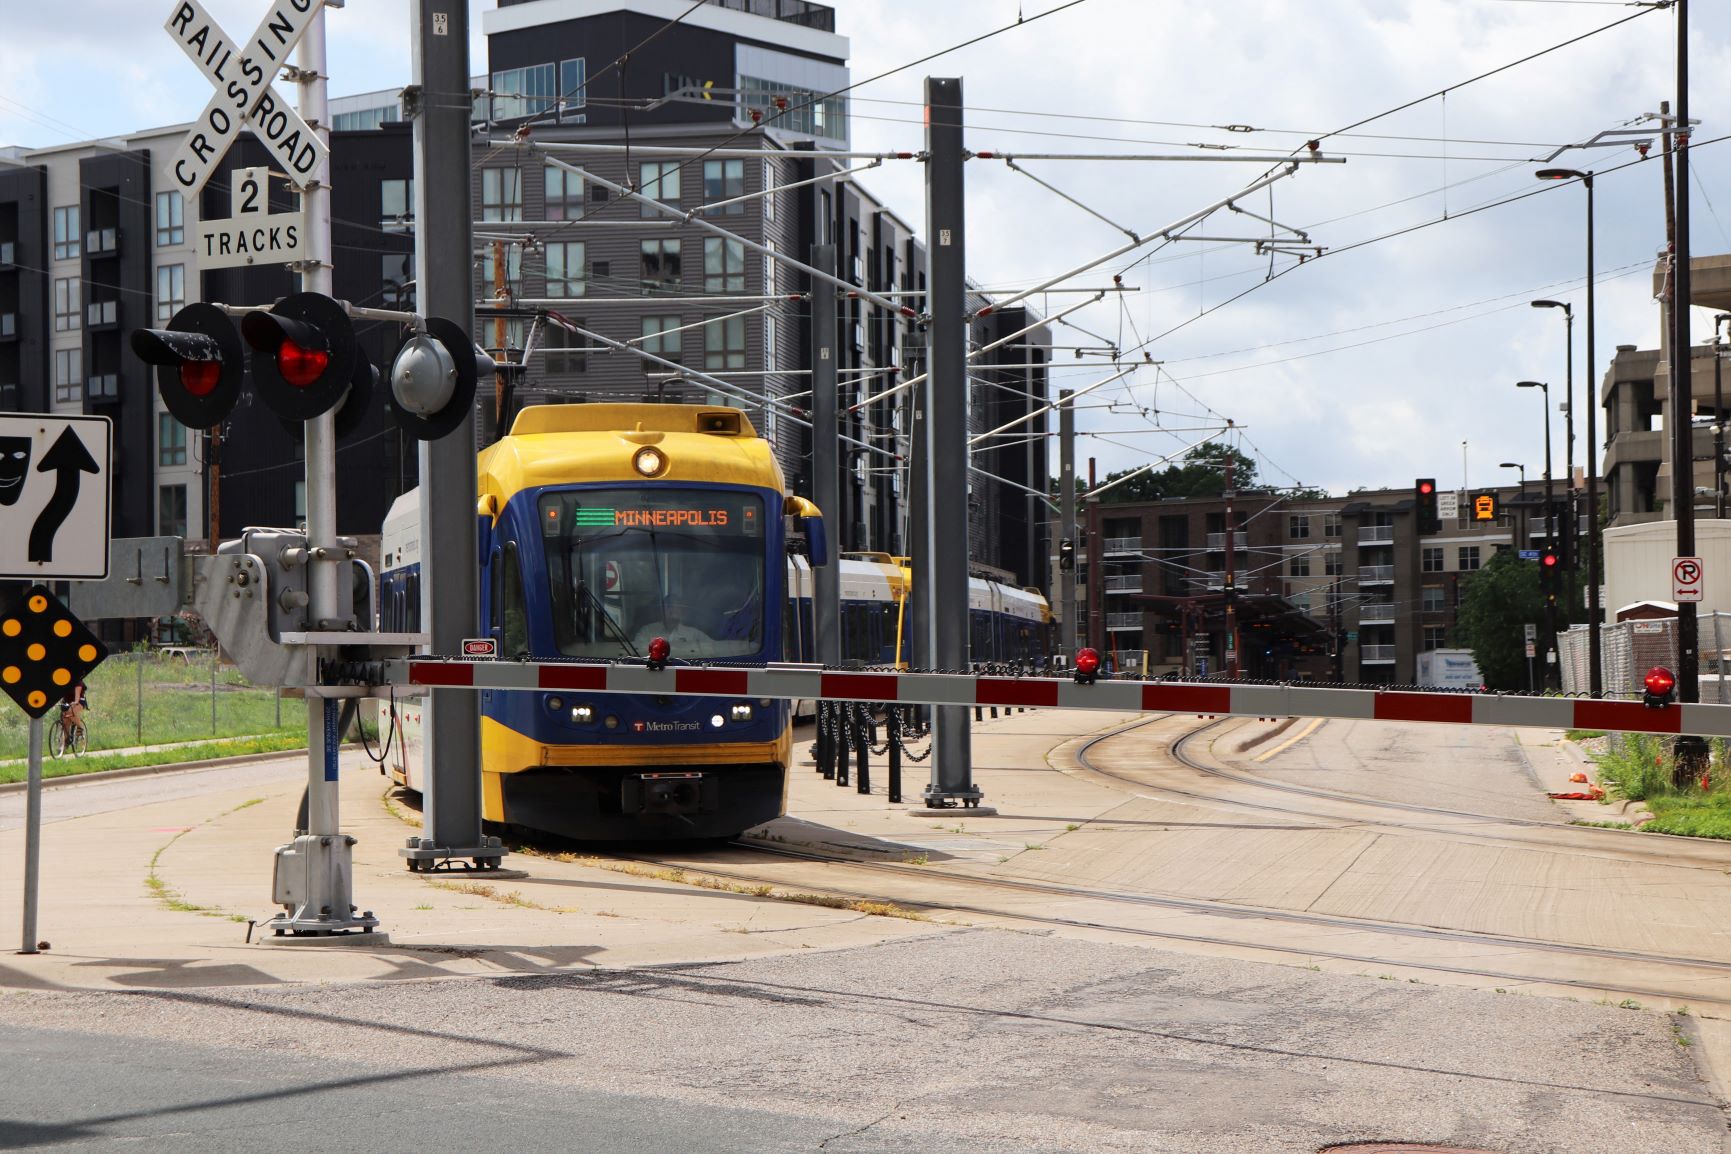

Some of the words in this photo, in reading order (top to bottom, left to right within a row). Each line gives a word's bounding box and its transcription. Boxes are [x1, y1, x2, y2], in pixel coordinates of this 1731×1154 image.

[438, 25, 443, 34] 6
[240, 179, 259, 214] 2
[204, 225, 298, 256] TRACKS
[615, 509, 729, 526] MINNEAPOLIS
[469, 644, 488, 652] DANGER
